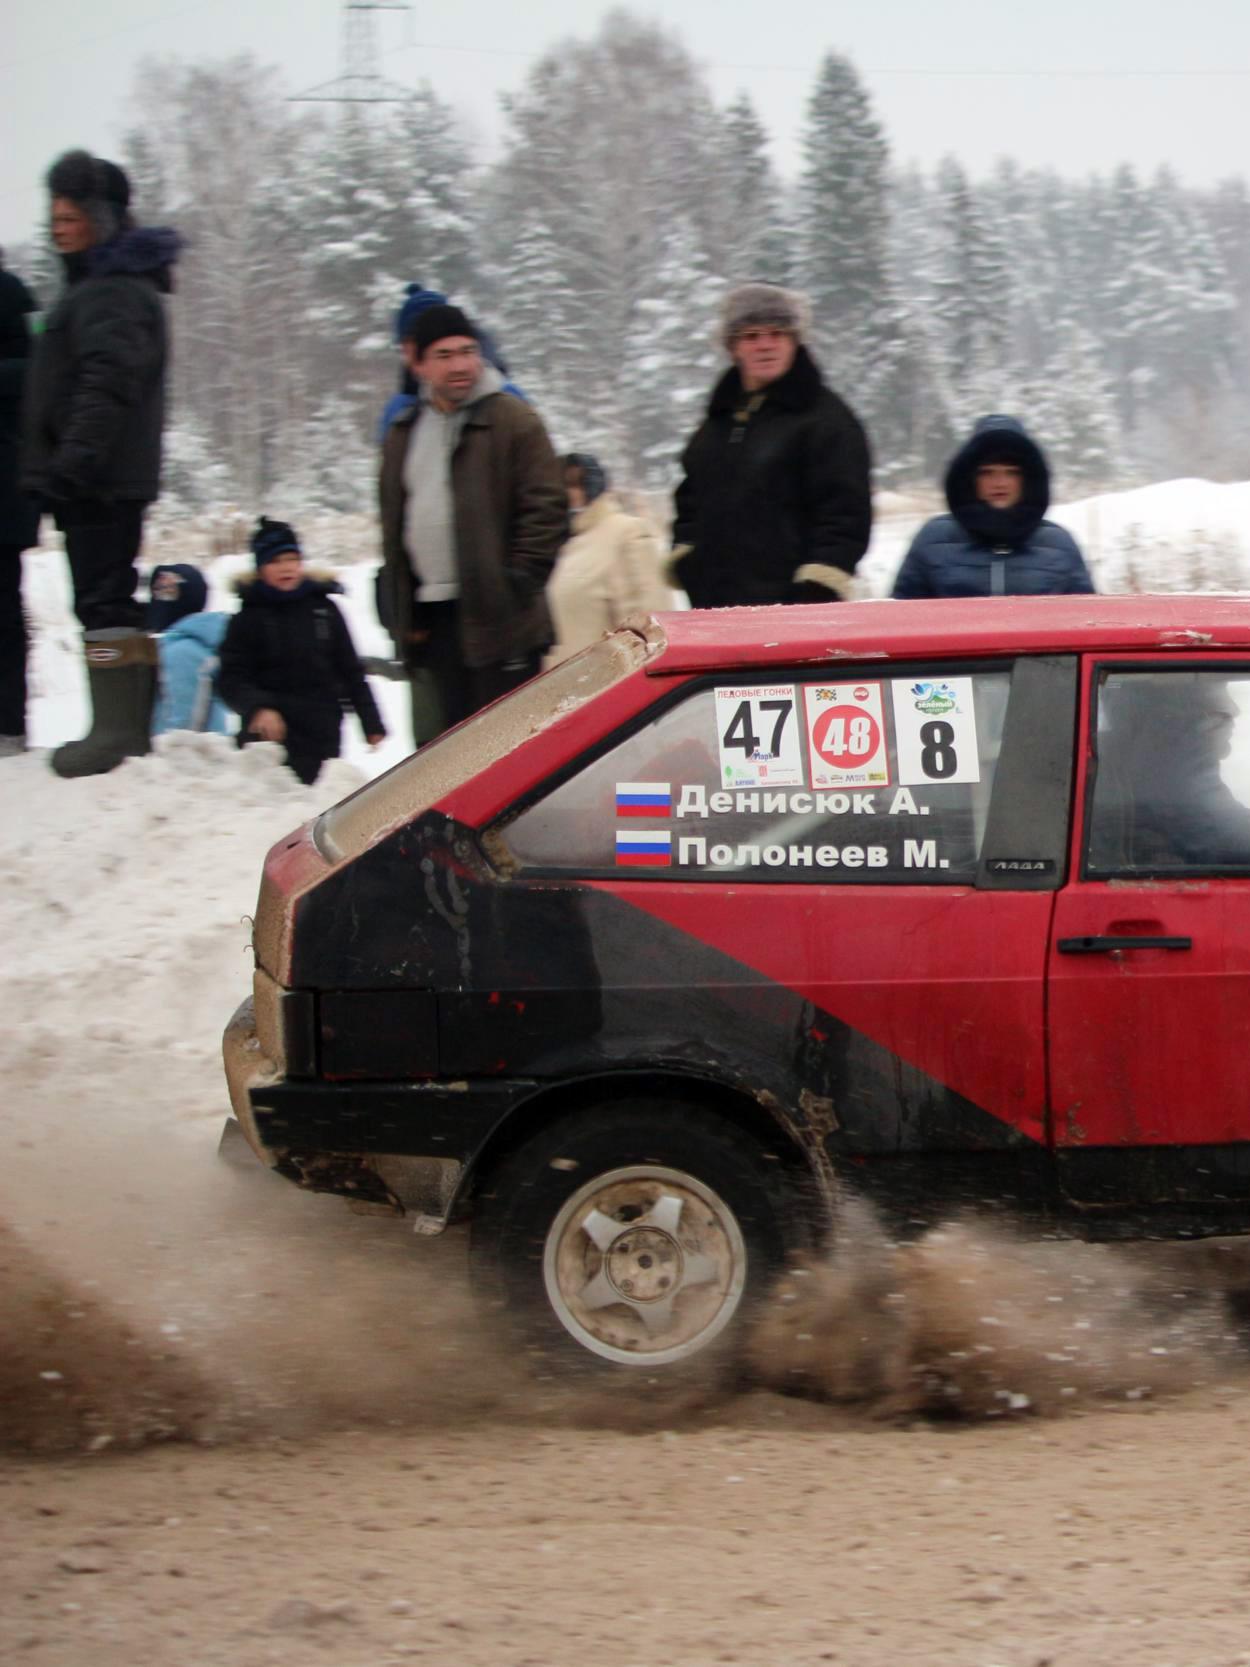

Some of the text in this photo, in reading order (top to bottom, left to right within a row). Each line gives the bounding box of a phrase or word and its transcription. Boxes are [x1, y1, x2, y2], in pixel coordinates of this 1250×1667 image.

[718, 687, 793, 698] ЛЕДОВЫЕ ГОНКИ
[723, 700, 793, 759] 47
[821, 717, 871, 756] 48
[920, 720, 958, 779] 8
[677, 785, 930, 818] Денисюк А.
[679, 837, 950, 868] Полонеев М.
[994, 861, 1045, 870] ЛАДА
